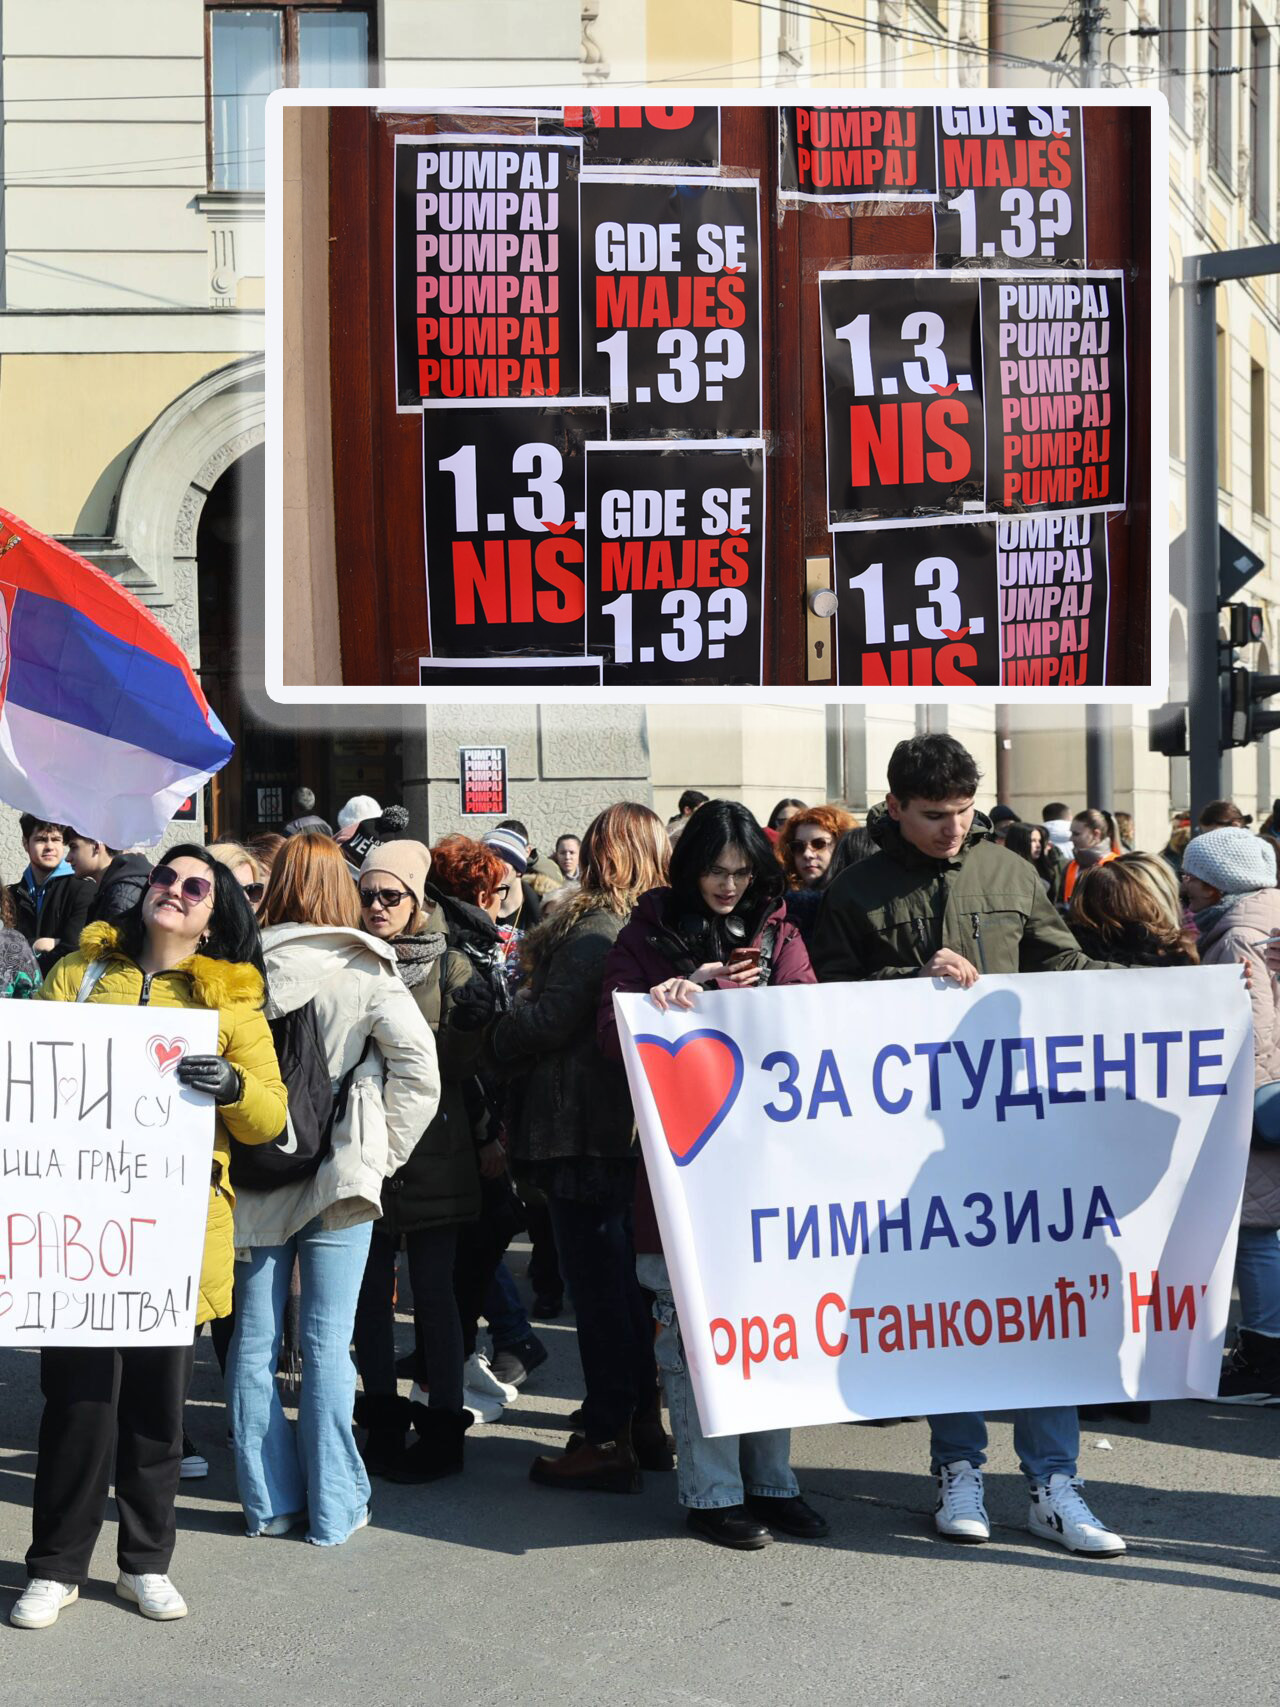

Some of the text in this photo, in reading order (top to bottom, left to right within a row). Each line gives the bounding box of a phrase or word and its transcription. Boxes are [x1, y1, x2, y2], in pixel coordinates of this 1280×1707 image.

[795, 107, 916, 148] PUMPAJ
[941, 106, 1071, 137] GDE SE
[417, 152, 559, 189] PUMPAJ
[797, 147, 917, 187] PUMPAJ
[942, 131, 1071, 189] MAJEŠ
[417, 193, 559, 231] PUMPAJ
[947, 188, 1072, 258] 1.3?
[417, 234, 559, 272] PUMPAJ
[595, 222, 747, 273] GDE SE
[417, 275, 559, 314] PUMPAJ
[595, 266, 746, 328] MAJEŠ
[999, 284, 1110, 320] PUMPAJ
[417, 317, 559, 356] PUMPAJ
[835, 310, 973, 396] 1.3.
[999, 321, 1110, 358] PUMPAJ
[417, 358, 559, 397] PUMPAJ
[596, 329, 746, 404] 1.3?
[999, 357, 1110, 395] PUMPAJ
[1002, 393, 1111, 433] PUMPAJ
[850, 383, 971, 487] NIŠ
[1003, 429, 1110, 470] PUMPAJ
[438, 442, 585, 532] 1.3.
[1003, 465, 1110, 507] PUMPAJ
[601, 487, 751, 539] GDE SE
[999, 514, 1091, 550] UMPAJ
[452, 520, 585, 625] NIŠ
[601, 528, 749, 592] MAJEŠ
[999, 548, 1093, 587] UMPAJ
[849, 556, 985, 645] 1.3.
[1000, 584, 1093, 622] UMPAJ
[601, 587, 748, 663] 1.3?
[1001, 618, 1090, 659] UMPAJ
[1002, 653, 1089, 686] UMPAJ
[465, 749, 501, 760] PUMPAJ
[465, 760, 501, 770] PUMPAJ
[466, 770, 502, 781] PUMPAJ
[466, 781, 502, 792] PUMPAJ
[466, 792, 503, 802] PUMPAJ
[466, 802, 503, 813] PUMPAJ
[350, 833, 377, 857] VE
[761, 1028, 1229, 1123] ЗА СТУДЕНТЕ
[133, 1095, 172, 1128] СУ
[77, 1140, 148, 1194] ГРАЂЕ
[165, 1155, 185, 1185] И
[750, 1185, 1122, 1265] ГИМНАЗИЈА
[15, 1275, 192, 1332] ДРУШТВА!
[709, 1313, 799, 1381] ора
[1128, 1270, 1208, 1335] Ни
